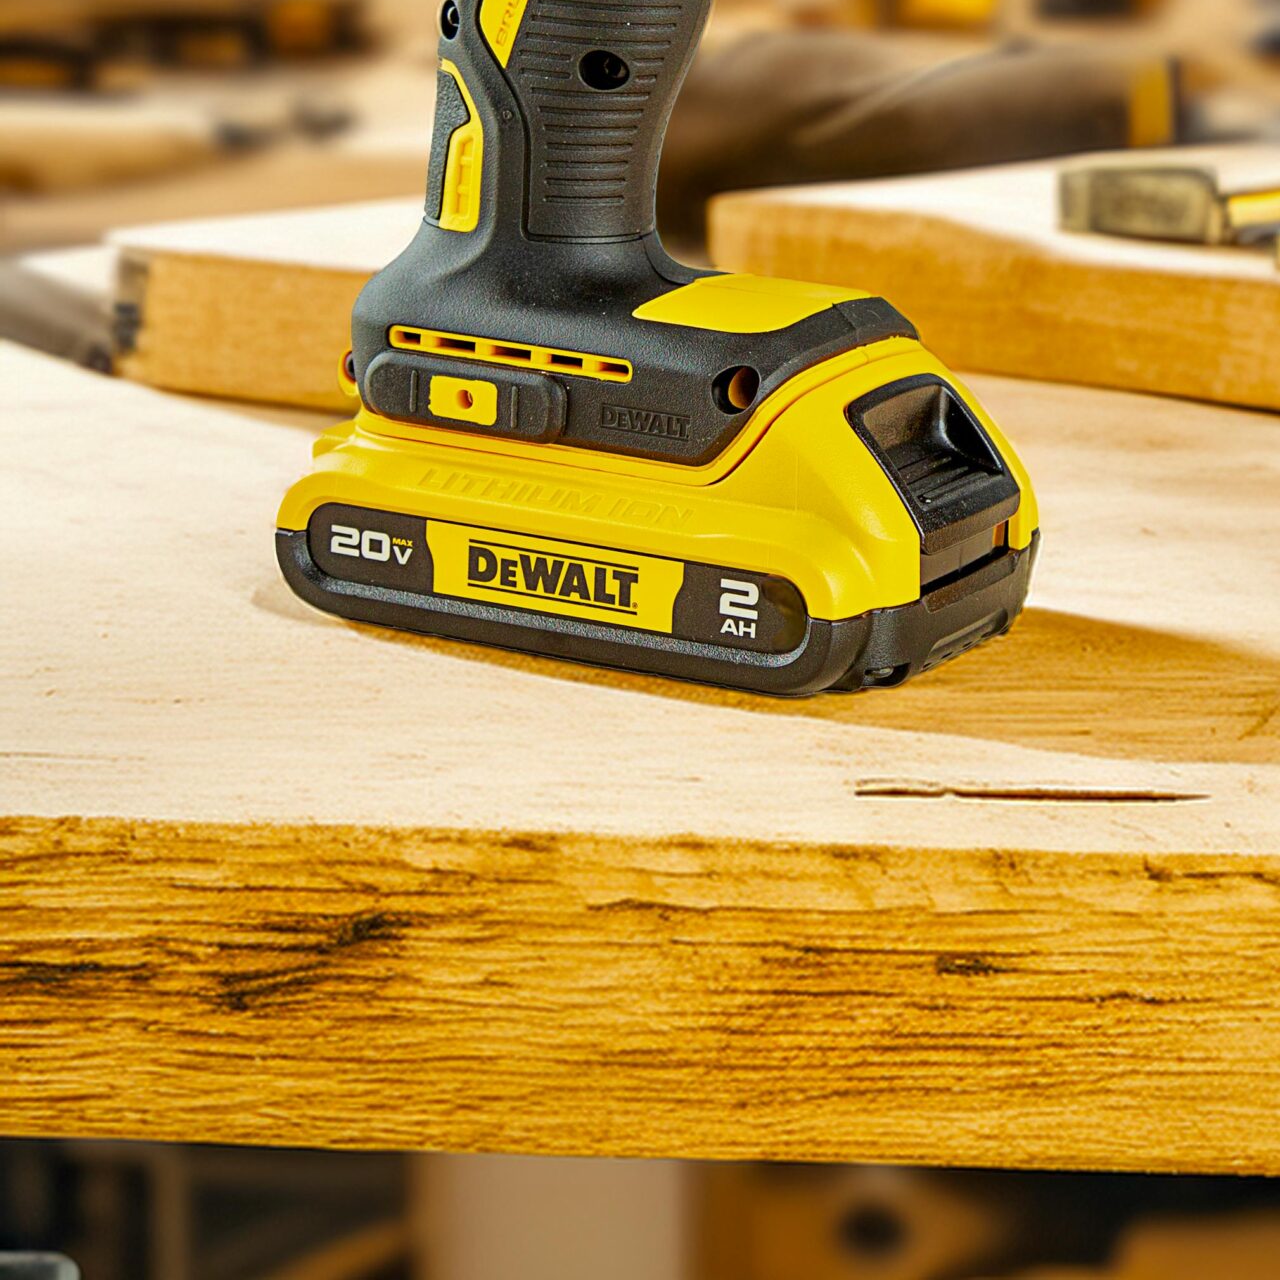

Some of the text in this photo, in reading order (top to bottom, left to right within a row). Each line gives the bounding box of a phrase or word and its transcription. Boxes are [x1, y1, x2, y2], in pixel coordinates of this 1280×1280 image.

[418, 468, 695, 528] LITHIUM ION
[392, 538, 413, 547] MAX
[720, 578, 759, 620] 2
[720, 618, 756, 639] AH
